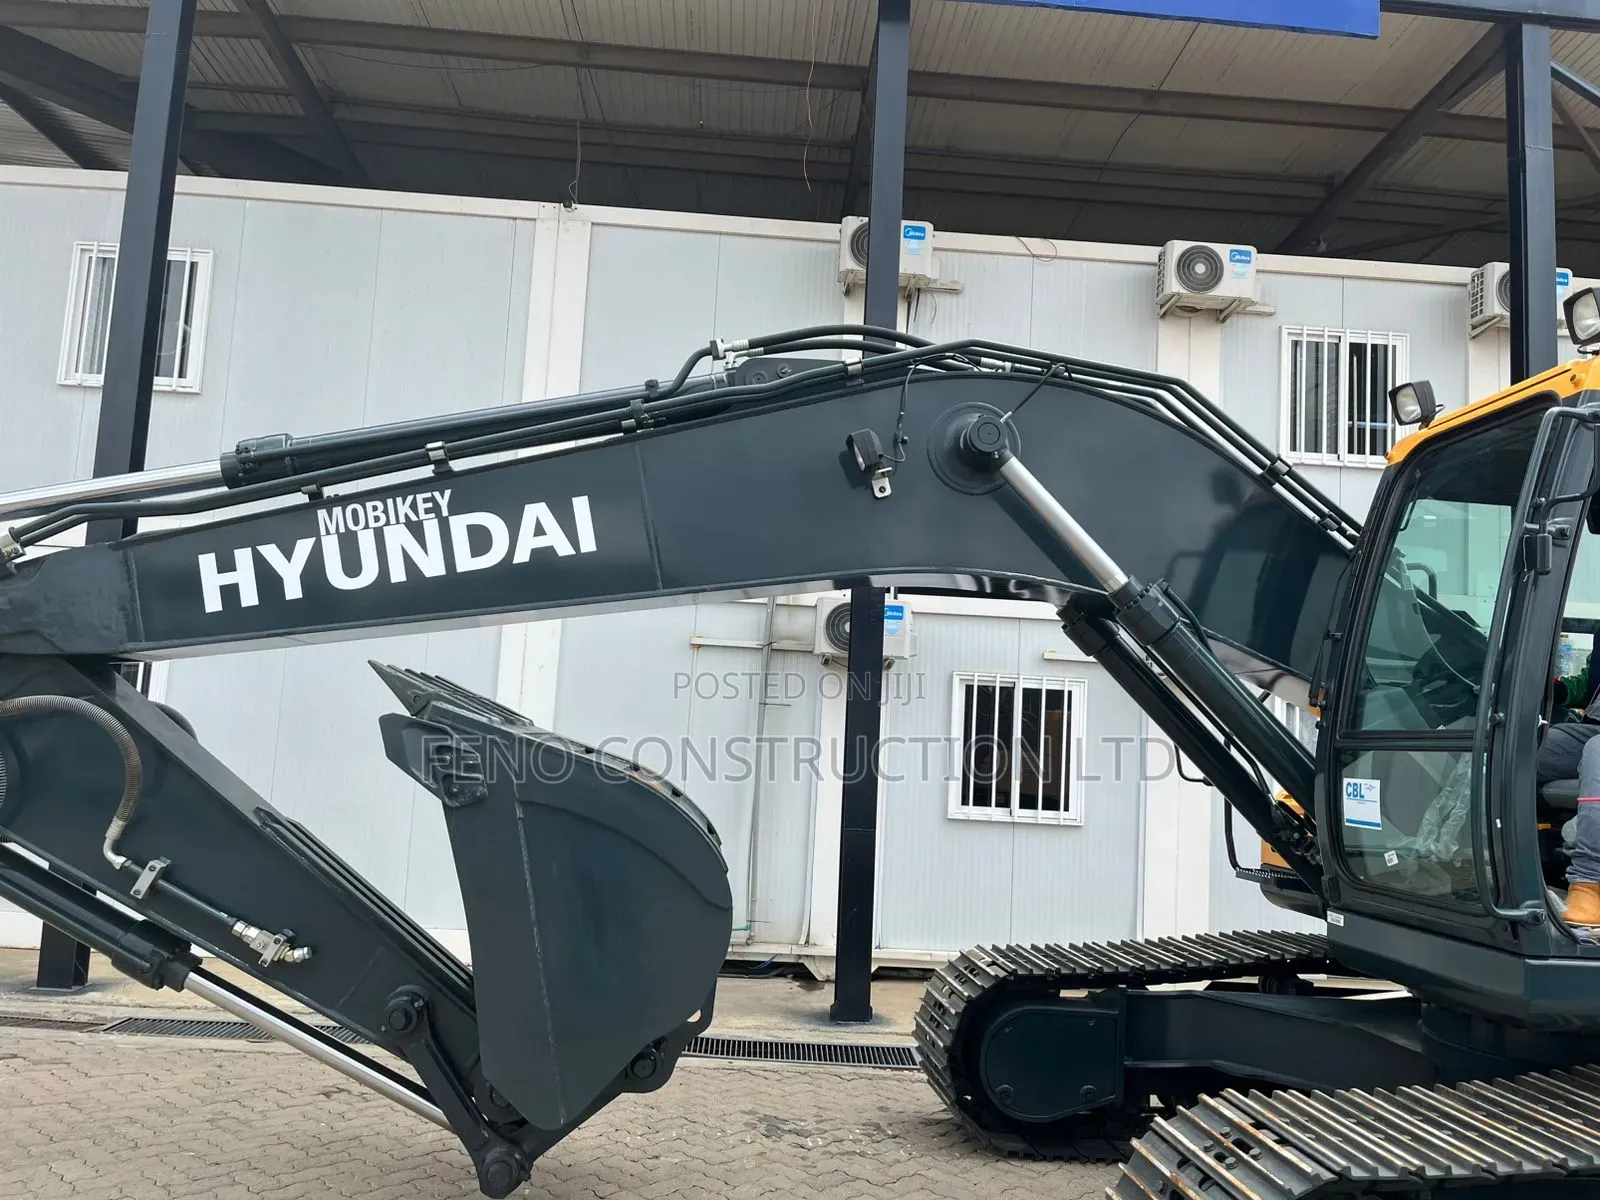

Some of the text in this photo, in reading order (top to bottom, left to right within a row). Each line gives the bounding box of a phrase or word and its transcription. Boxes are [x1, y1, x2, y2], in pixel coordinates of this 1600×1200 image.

[317, 489, 452, 535] MOBIKEY
[198, 495, 597, 613] HYUNDAI
[1346, 782, 1365, 798] CBL
